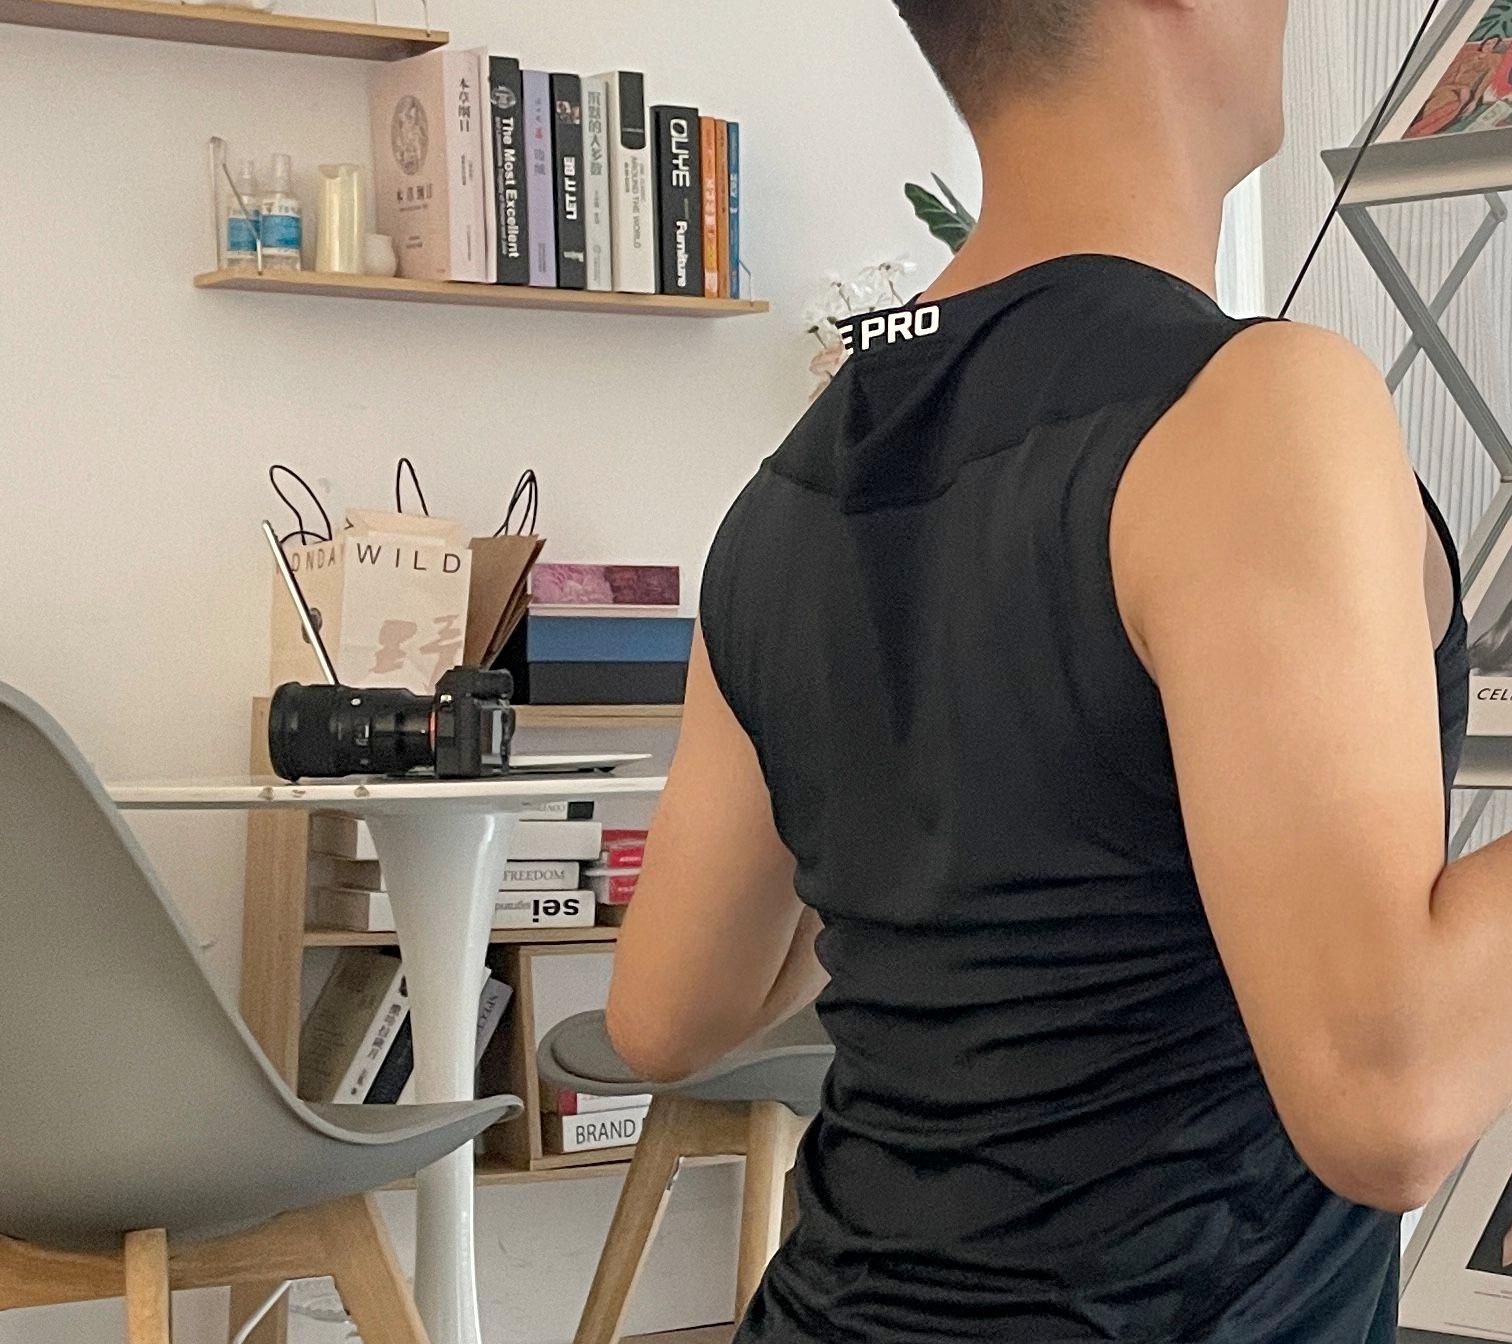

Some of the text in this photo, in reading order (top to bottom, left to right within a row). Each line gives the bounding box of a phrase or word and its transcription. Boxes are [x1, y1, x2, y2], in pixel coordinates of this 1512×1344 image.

[502, 117, 520, 258] The Most Excellent
[563, 156, 578, 220] LET IT BE
[860, 305, 940, 350] PRO
[356, 542, 462, 574] WILD
[503, 869, 566, 882] FREEDOM
[575, 1118, 636, 1145] BRAND
